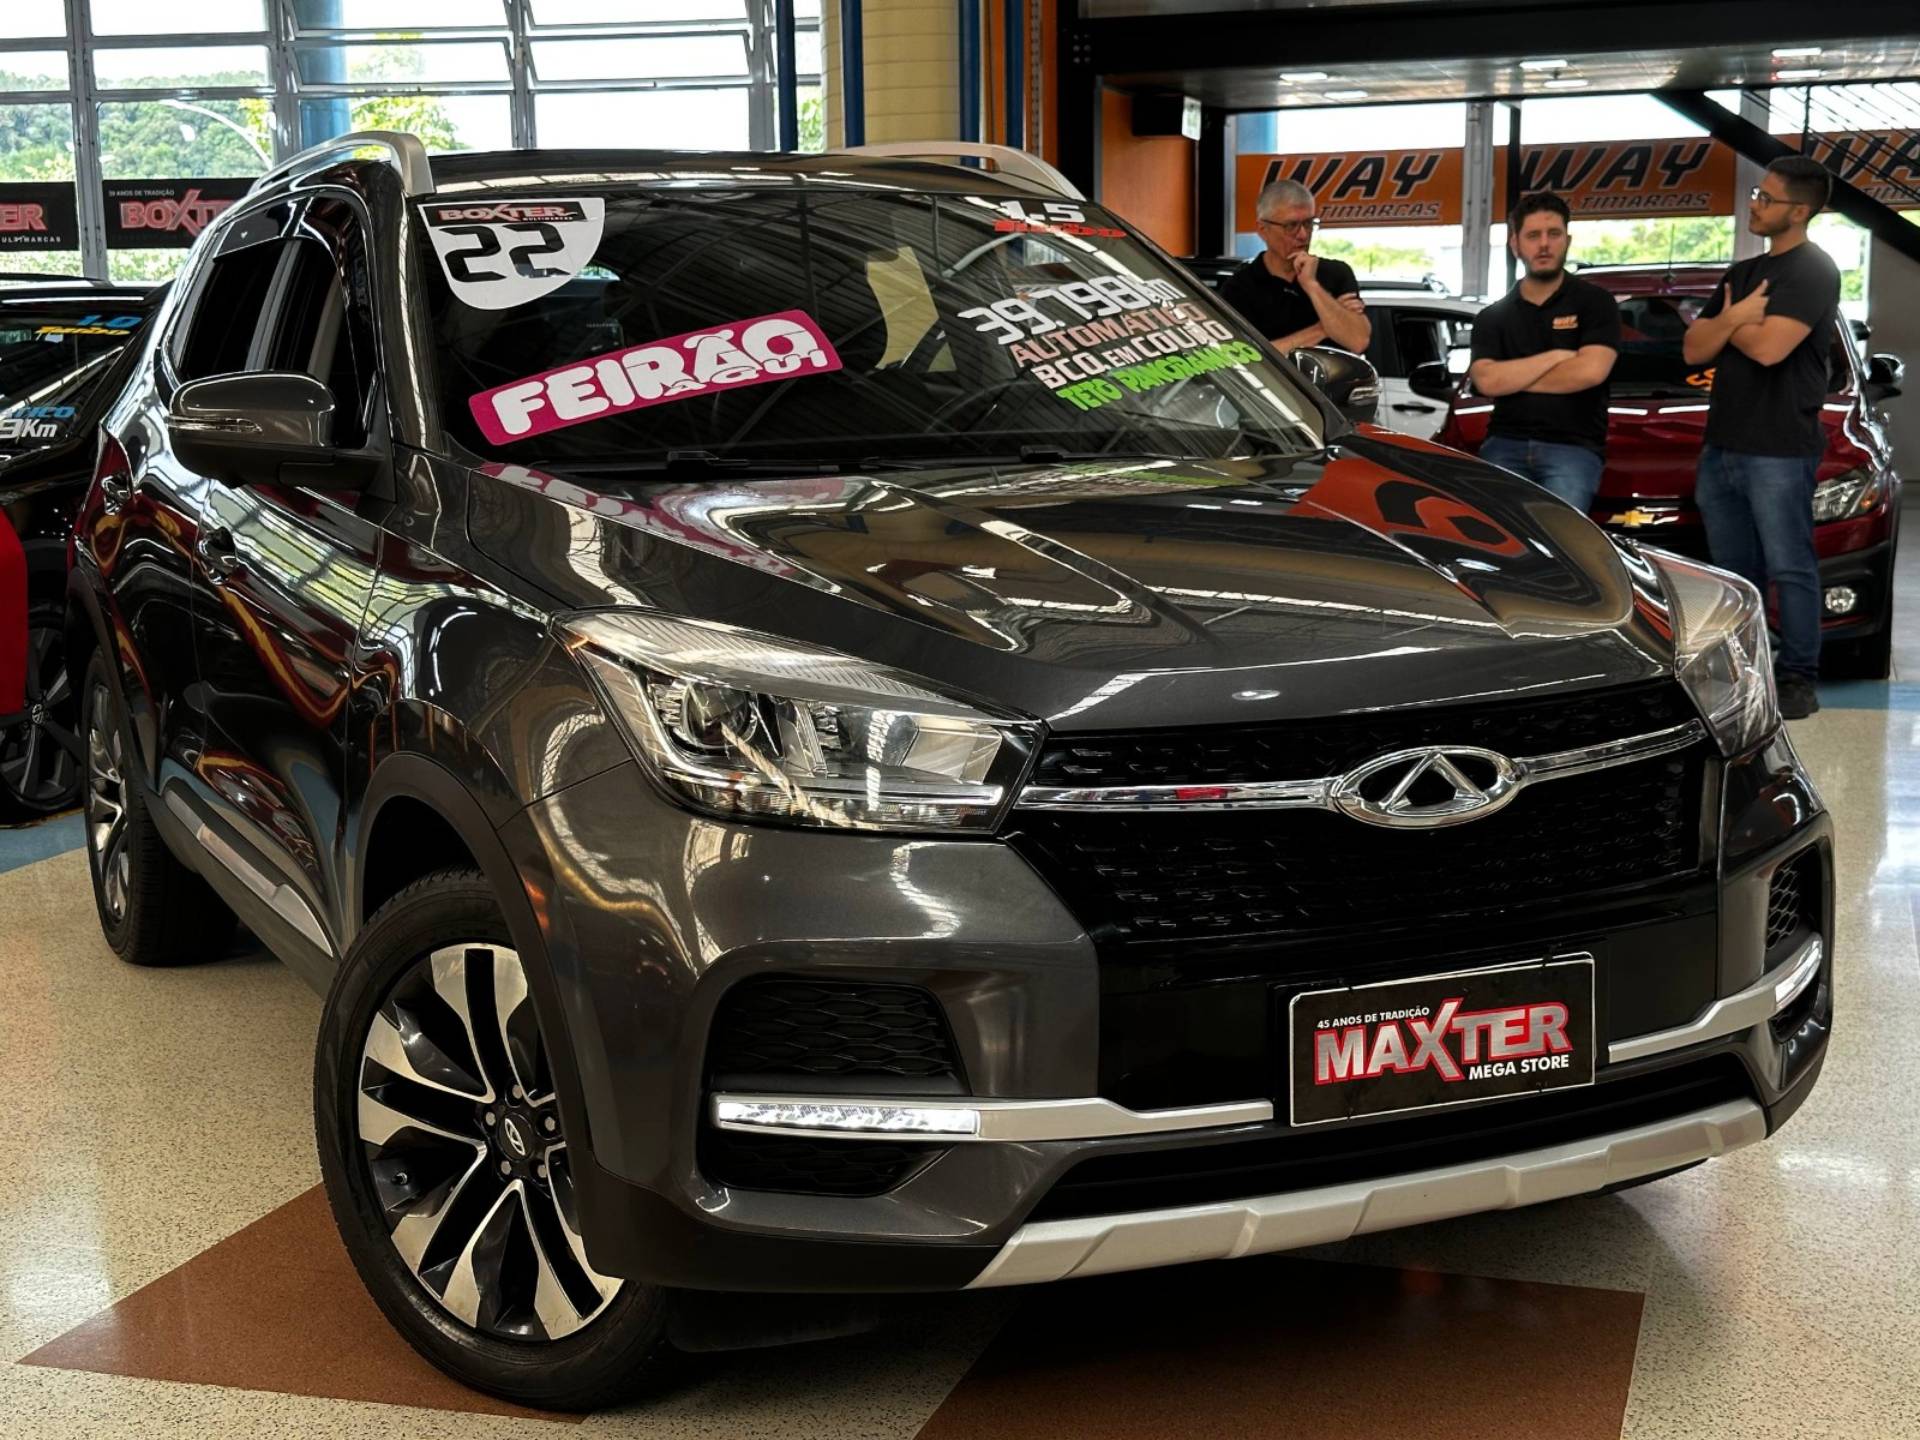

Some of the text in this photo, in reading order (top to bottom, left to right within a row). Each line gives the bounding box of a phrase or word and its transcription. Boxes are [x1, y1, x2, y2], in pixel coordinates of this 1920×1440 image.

[1262, 153, 1443, 200] WAY
[1520, 143, 1714, 193] WAY
[438, 204, 568, 222] BOXTER
[1000, 200, 1086, 222] 1.5
[438, 222, 571, 283] 22
[77, 315, 143, 328] 1.0
[1101, 345, 1139, 367] EM
[1130, 319, 1234, 359] COURO
[491, 318, 819, 435] FEIRÃO
[1056, 377, 1123, 411] TETO
[1317, 1005, 1430, 1029] 45 ANOS DE TRADIÇÃO
[1314, 997, 1574, 1086] MAXTER
[1468, 1054, 1570, 1081] MEGA STORE
